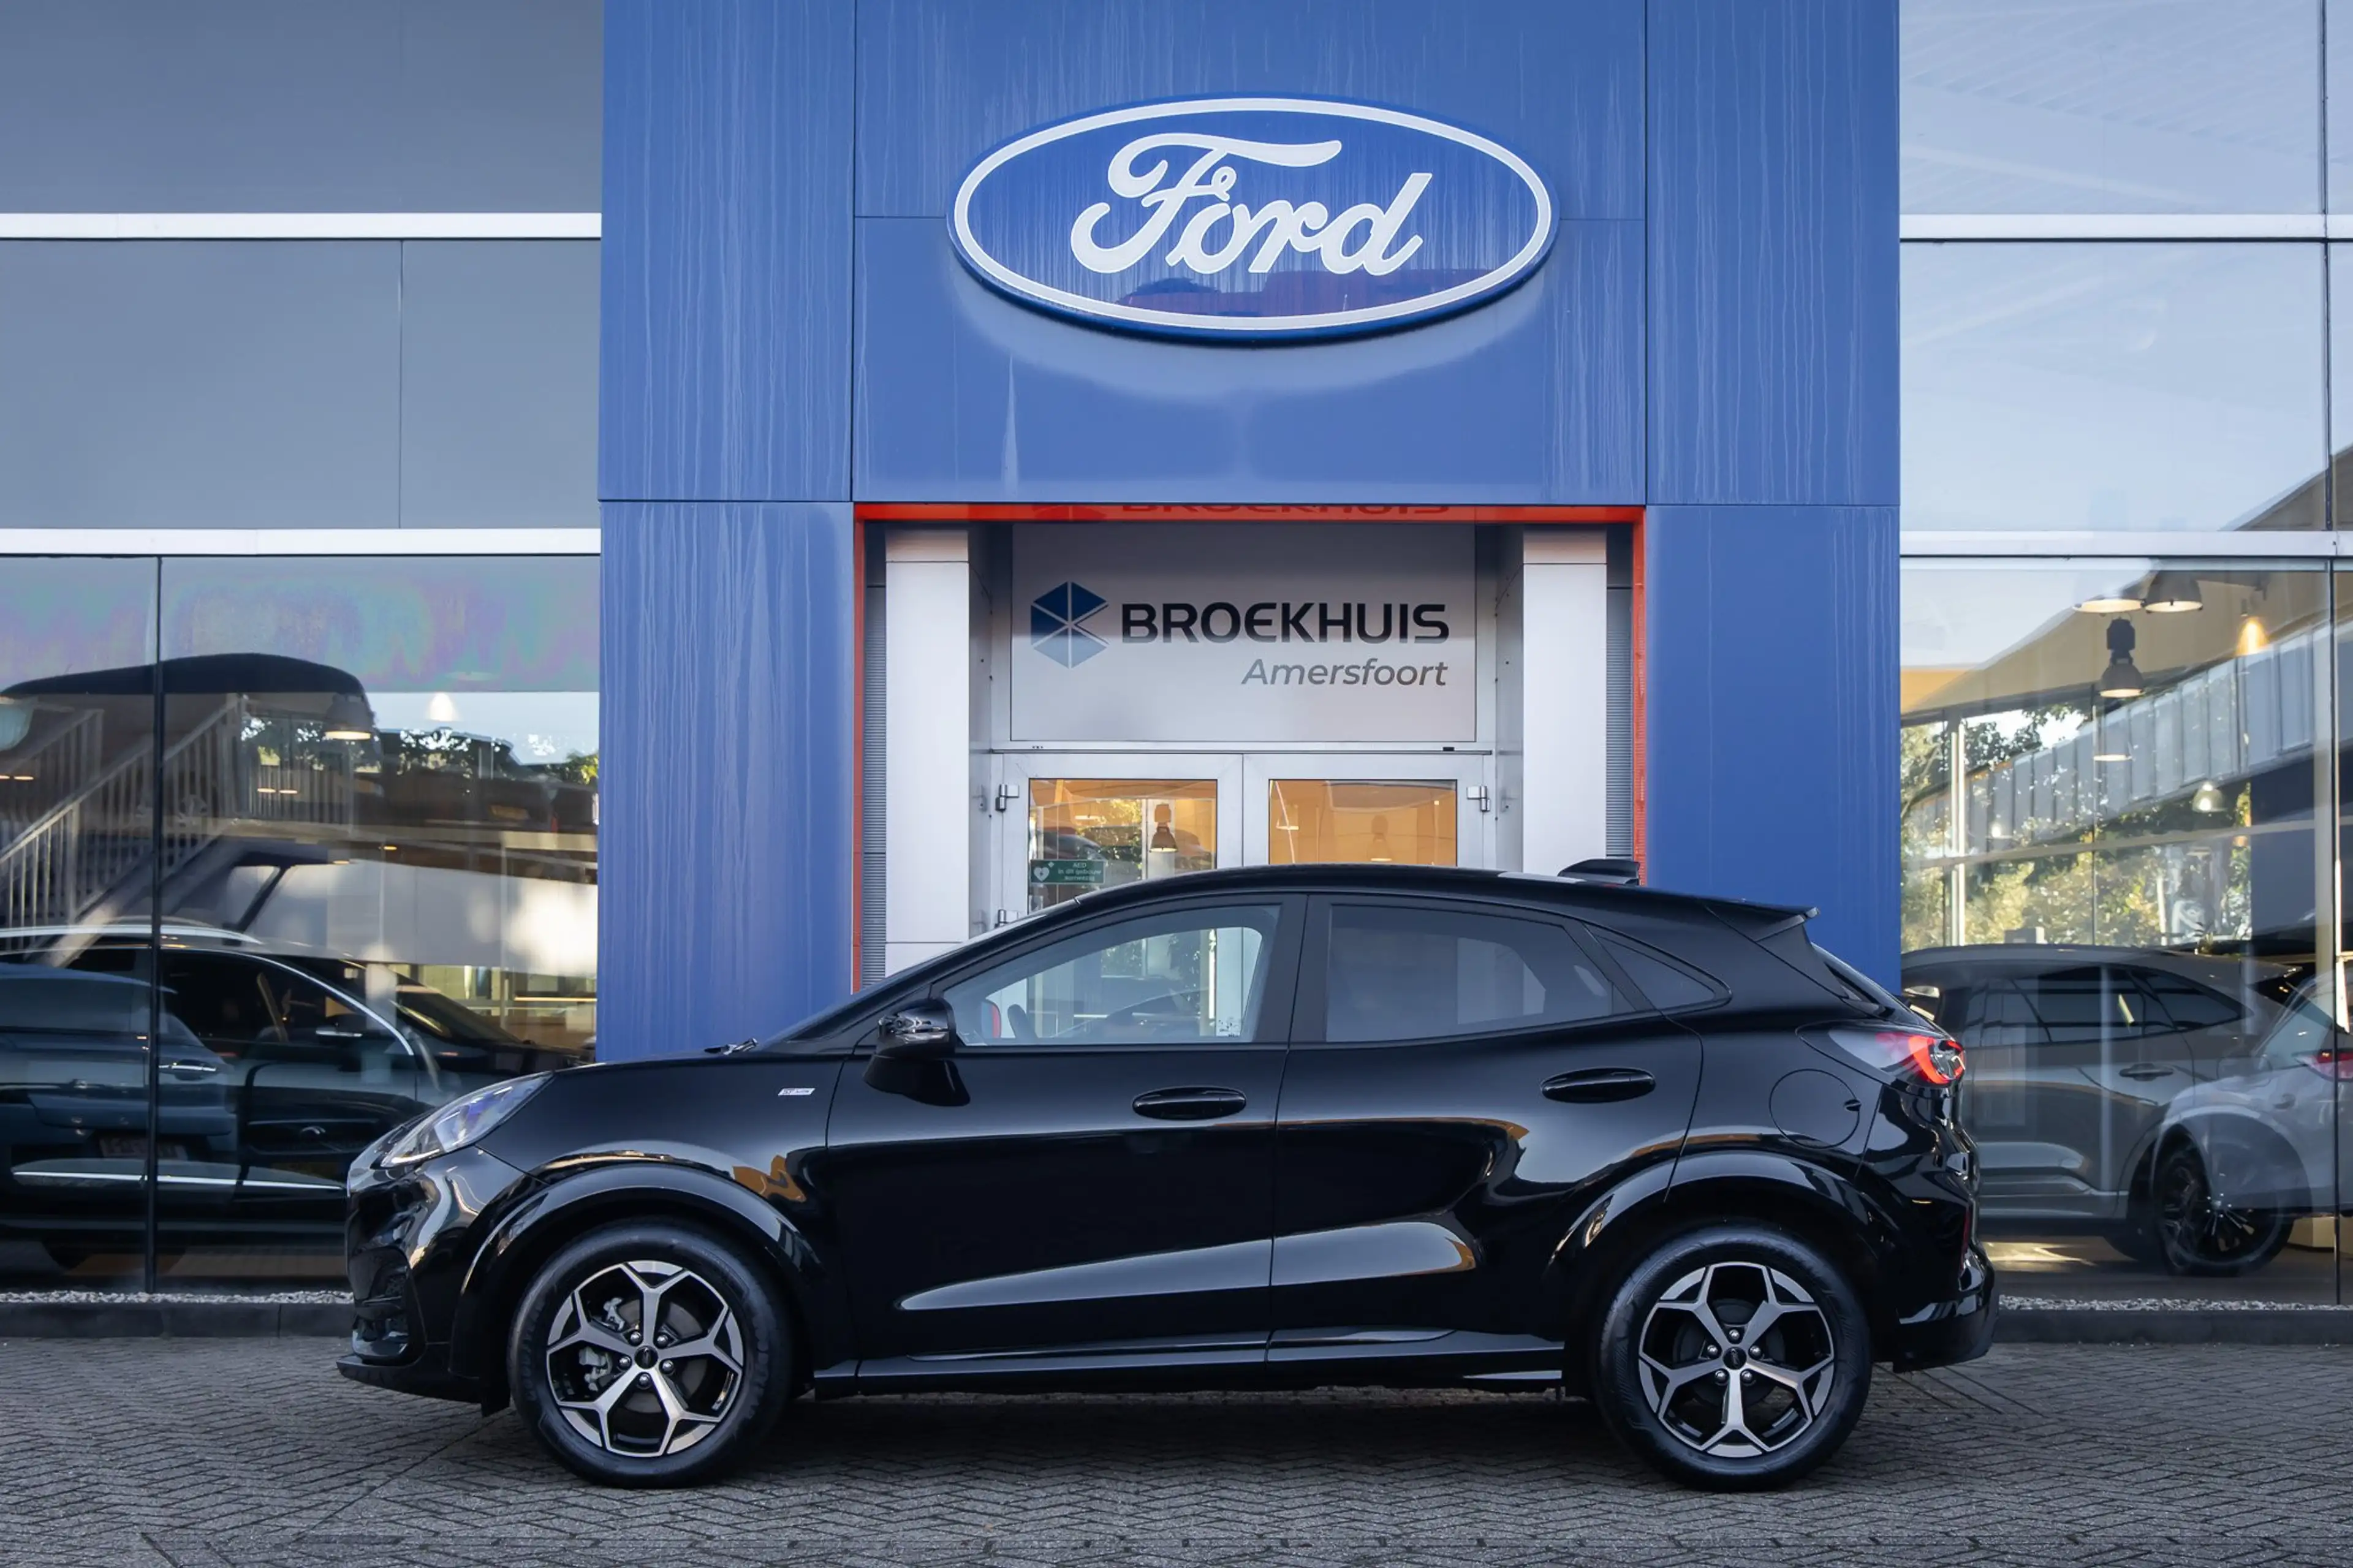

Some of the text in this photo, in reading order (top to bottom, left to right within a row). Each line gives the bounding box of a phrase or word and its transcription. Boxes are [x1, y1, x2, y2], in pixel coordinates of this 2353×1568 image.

[1070, 132, 1433, 276] Ford
[1121, 602, 1450, 645] BROEKHUIS
[1241, 657, 1449, 686] Amersfoort
